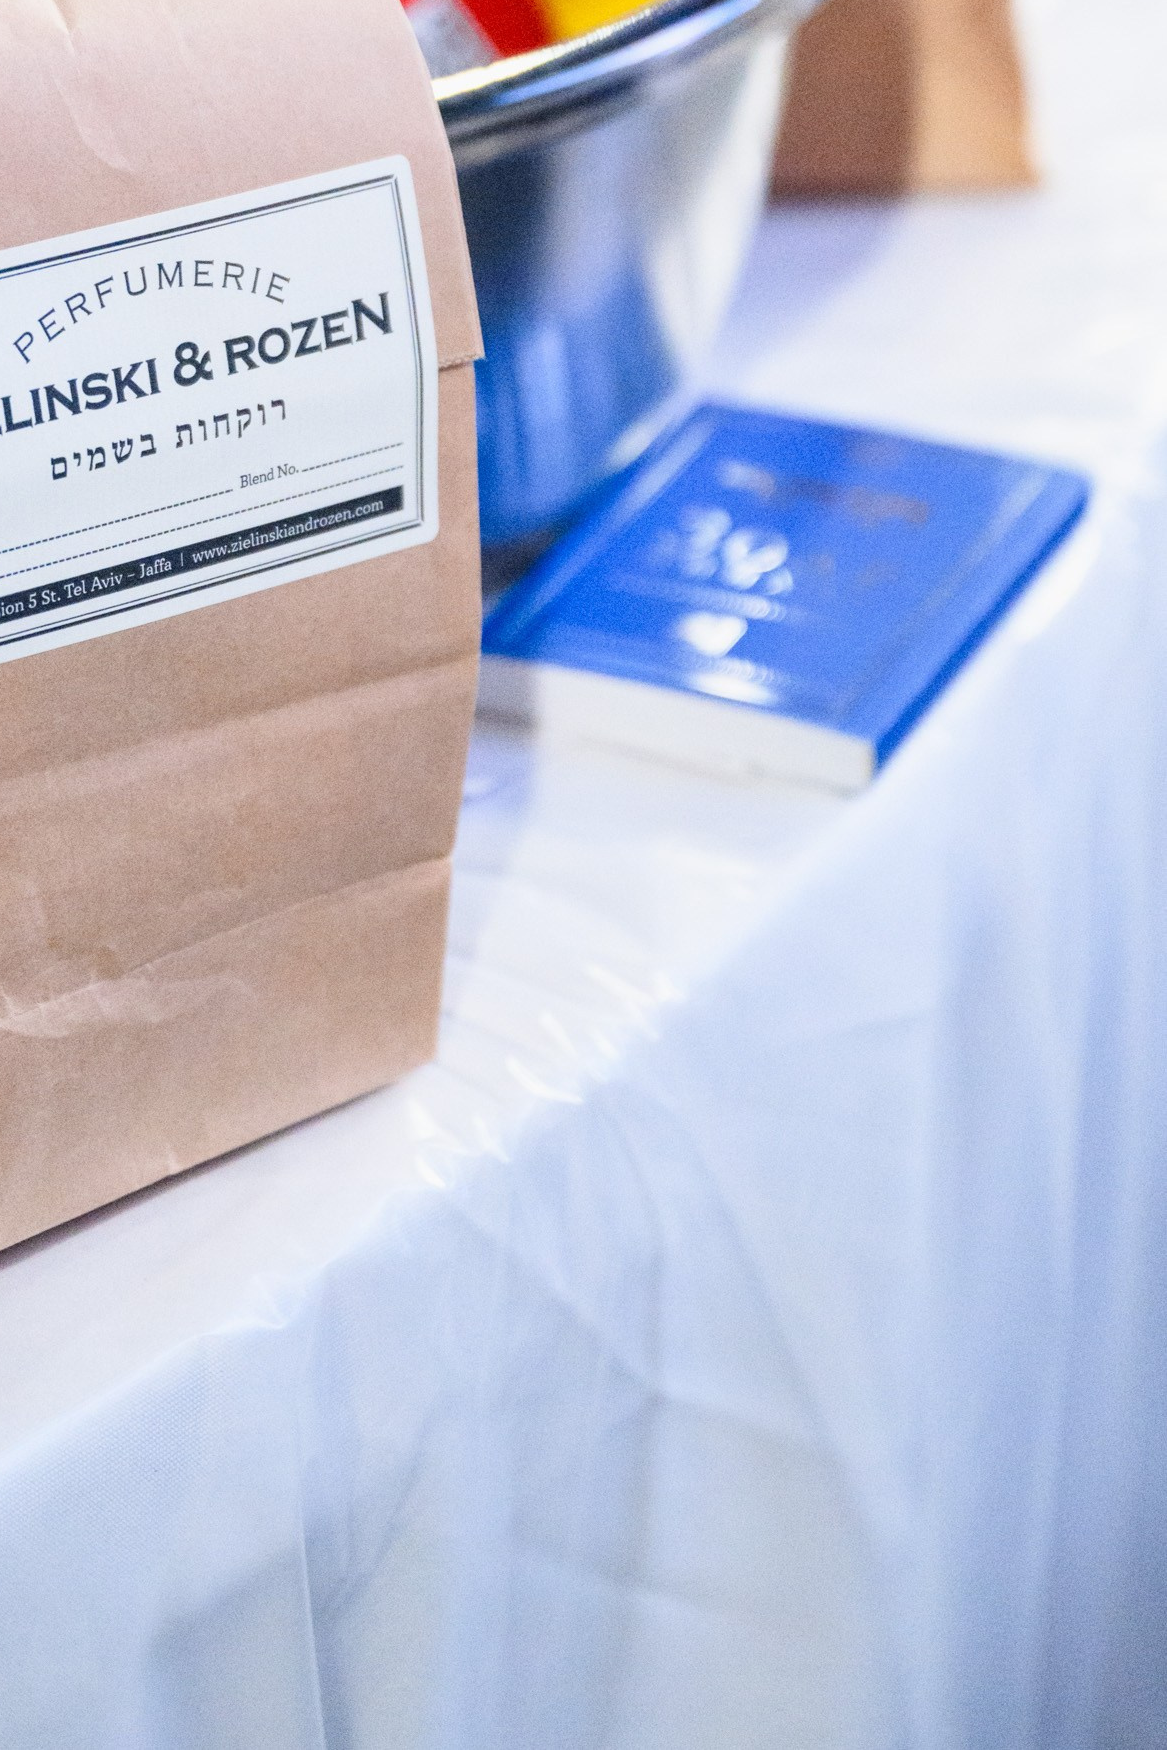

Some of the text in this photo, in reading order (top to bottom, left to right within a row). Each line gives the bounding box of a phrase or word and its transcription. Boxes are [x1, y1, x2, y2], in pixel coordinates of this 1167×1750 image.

[12, 259, 291, 364] PERFUMERIE
[172, 341, 214, 387] &
[223, 291, 394, 376] ROZEN
[50, 398, 287, 481] רוקחות בשמים
[239, 467, 275, 489] Blend
[277, 462, 300, 478] No.
[28, 592, 38, 609] 5
[41, 588, 61, 606] St.
[64, 579, 88, 599] Tel
[91, 571, 124, 592] Aviv
[139, 557, 173, 579] Jaffa
[192, 499, 384, 564] www.zielinskiandrozen.com
